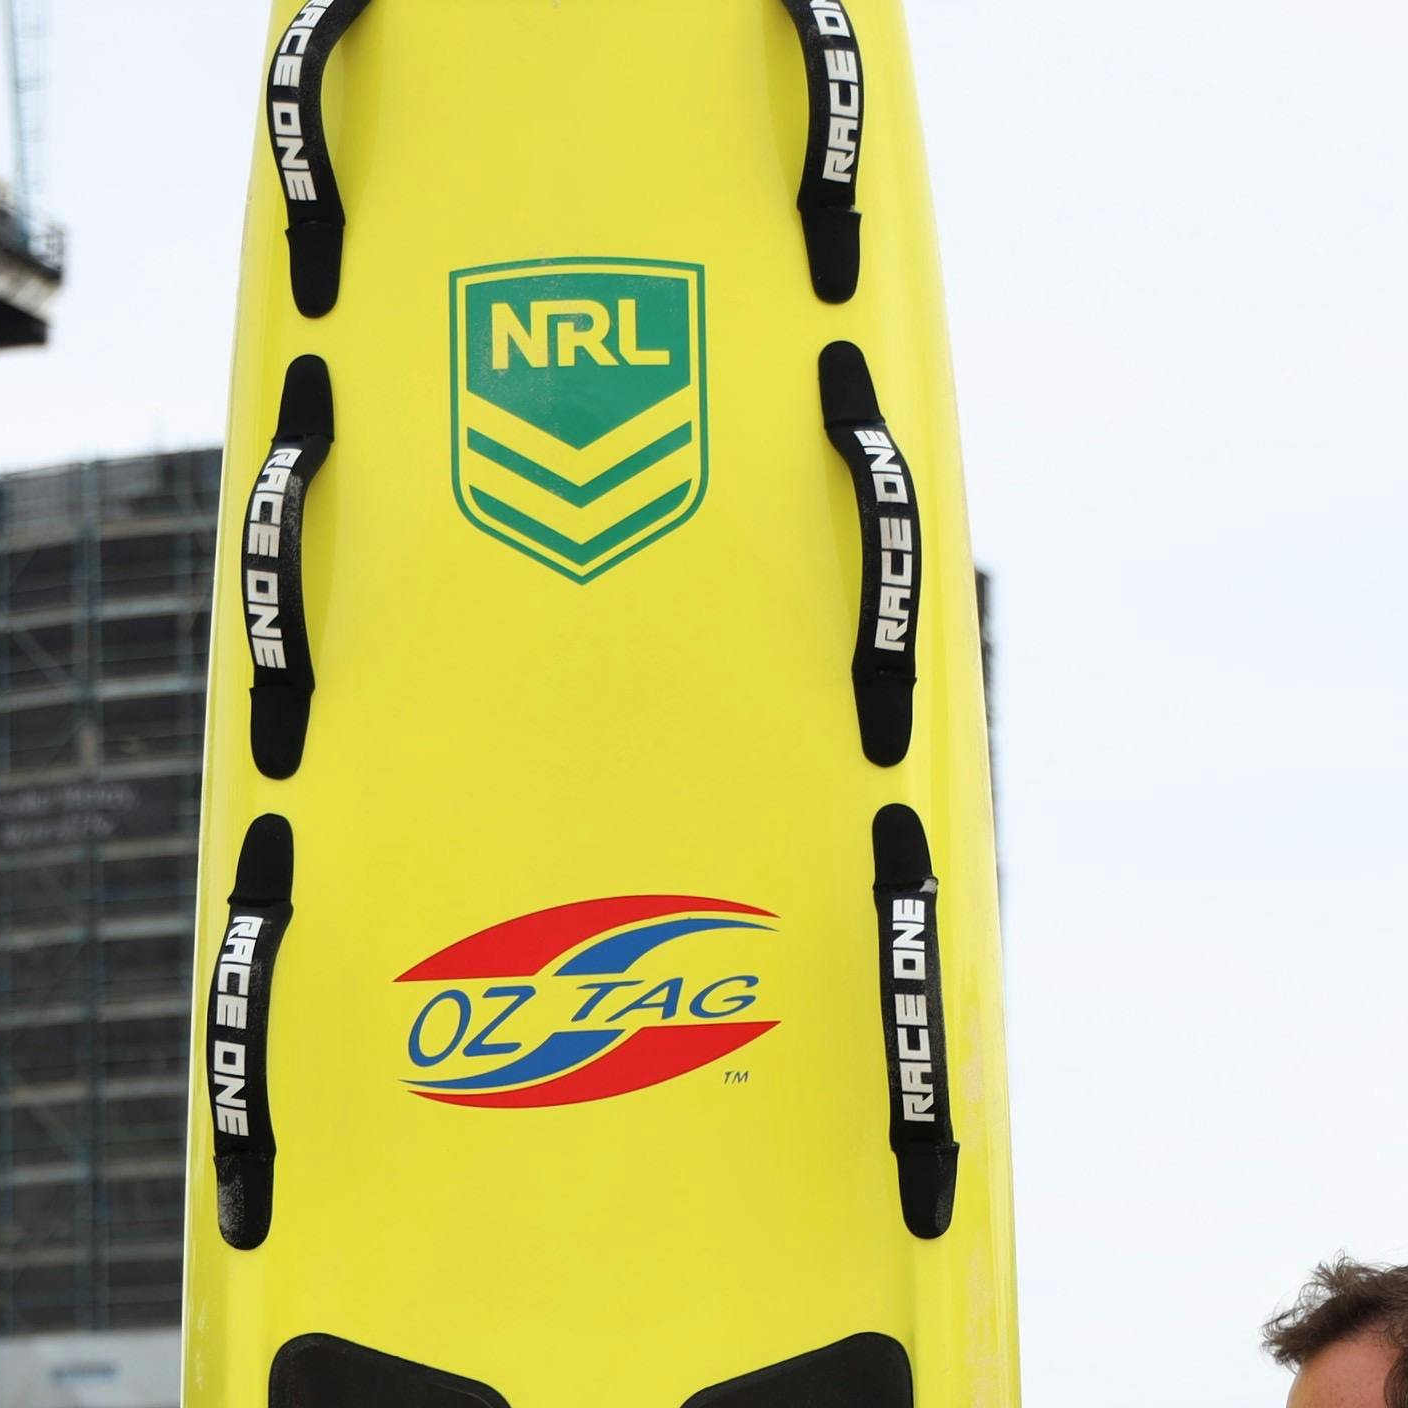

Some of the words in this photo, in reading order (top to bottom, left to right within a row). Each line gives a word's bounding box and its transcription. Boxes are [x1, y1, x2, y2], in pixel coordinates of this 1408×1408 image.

[273, 0, 334, 88] ACE
[272, 101, 318, 201] ONE
[822, 49, 859, 183] RACE
[491, 298, 671, 371] NRL
[247, 448, 303, 558] RACE
[853, 430, 909, 504] ONE
[246, 569, 287, 669] ONE
[874, 516, 913, 652] RACE
[215, 915, 264, 1030] RACE
[892, 898, 926, 981] ONE
[408, 985, 537, 1068] OZ
[570, 975, 760, 1023] TAG
[894, 993, 936, 1123] RACE
[213, 1040, 250, 1137] ONE
[724, 1070, 750, 1085] TM
